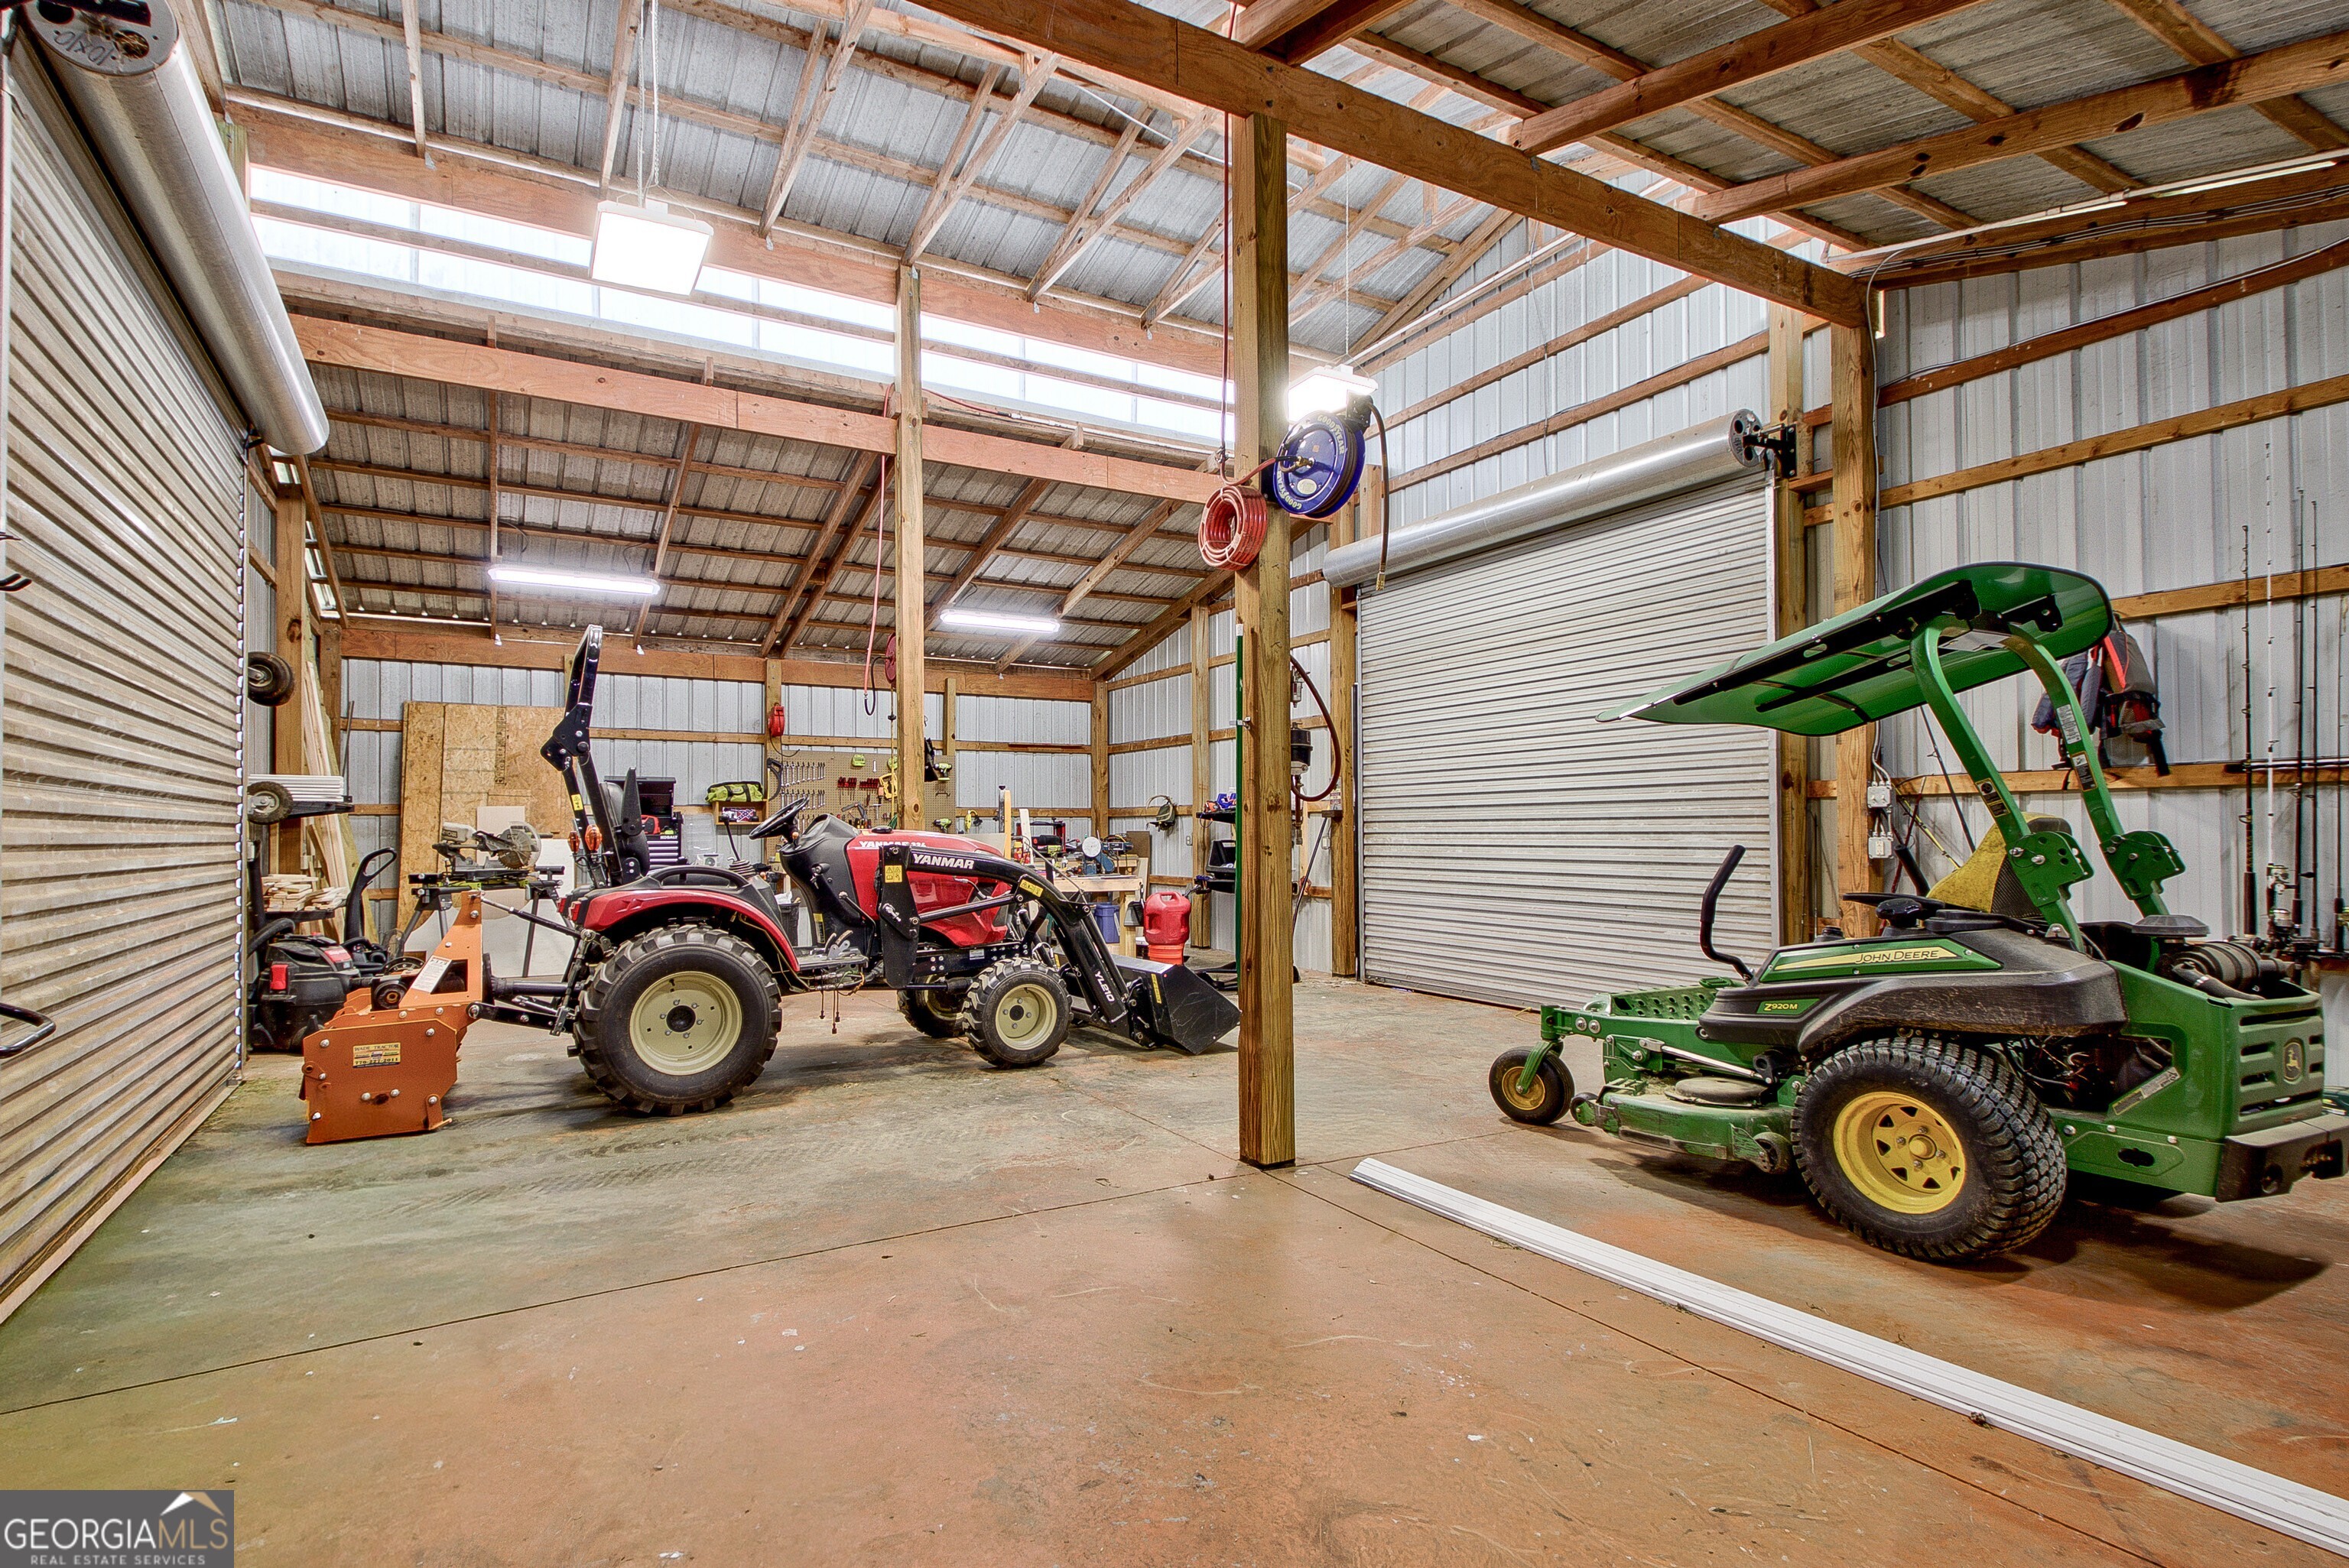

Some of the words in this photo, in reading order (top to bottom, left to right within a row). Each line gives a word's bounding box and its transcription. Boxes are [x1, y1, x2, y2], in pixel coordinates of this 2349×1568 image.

[1317, 414, 1345, 455] GOODYEAR
[912, 853, 975, 869] YANMAR
[1856, 953, 1891, 963] JOHN
[1893, 950, 1939, 960] DEERE
[1094, 970, 1115, 1002] YL210
[1763, 1003, 1798, 1011] Z920M
